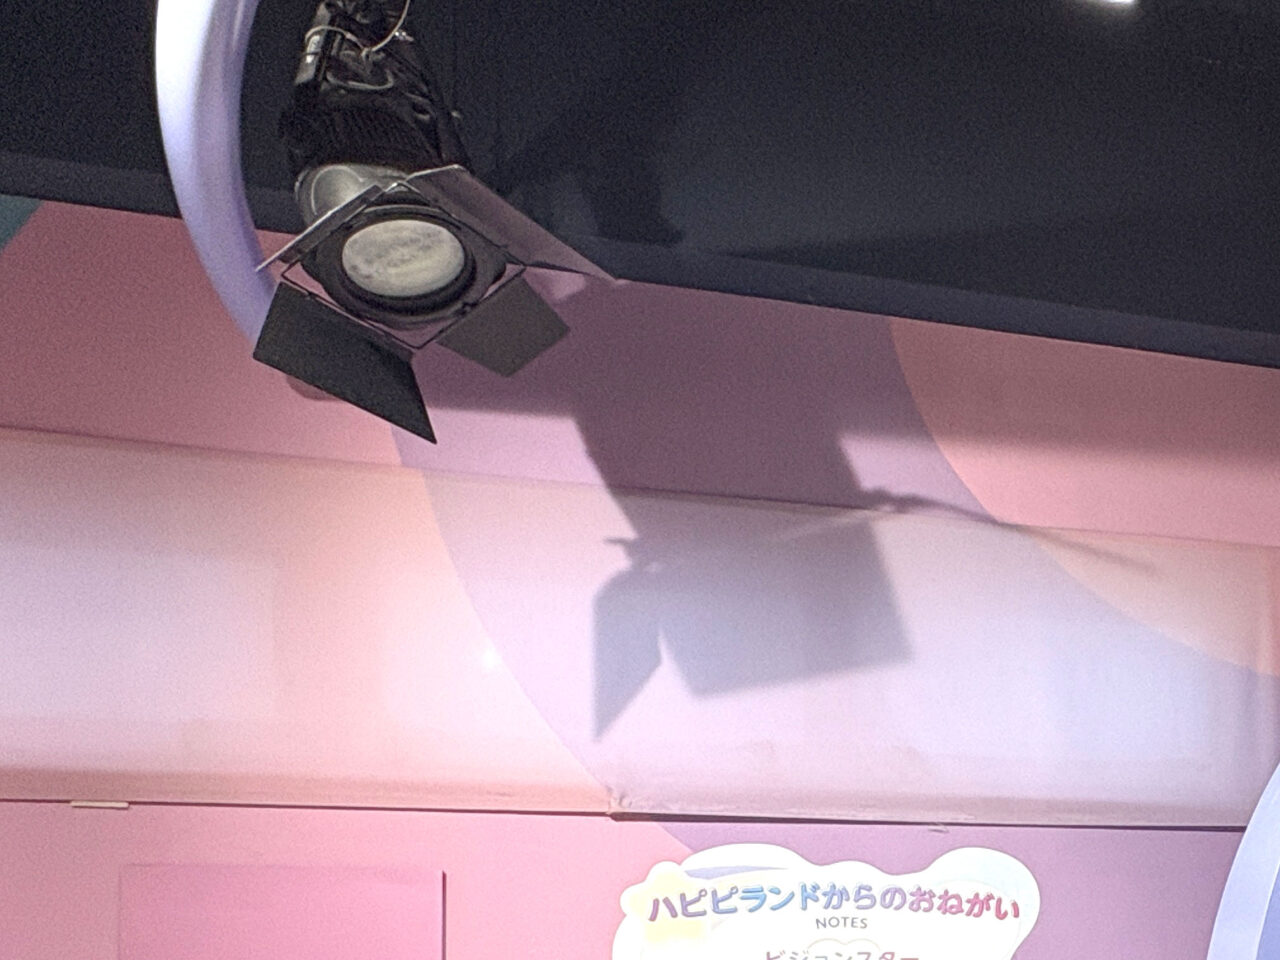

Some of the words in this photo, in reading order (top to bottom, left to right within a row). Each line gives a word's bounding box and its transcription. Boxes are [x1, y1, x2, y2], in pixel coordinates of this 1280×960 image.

[648, 882, 1020, 921] ハピピランドからのおねがい
[815, 916, 868, 929] NOTES
